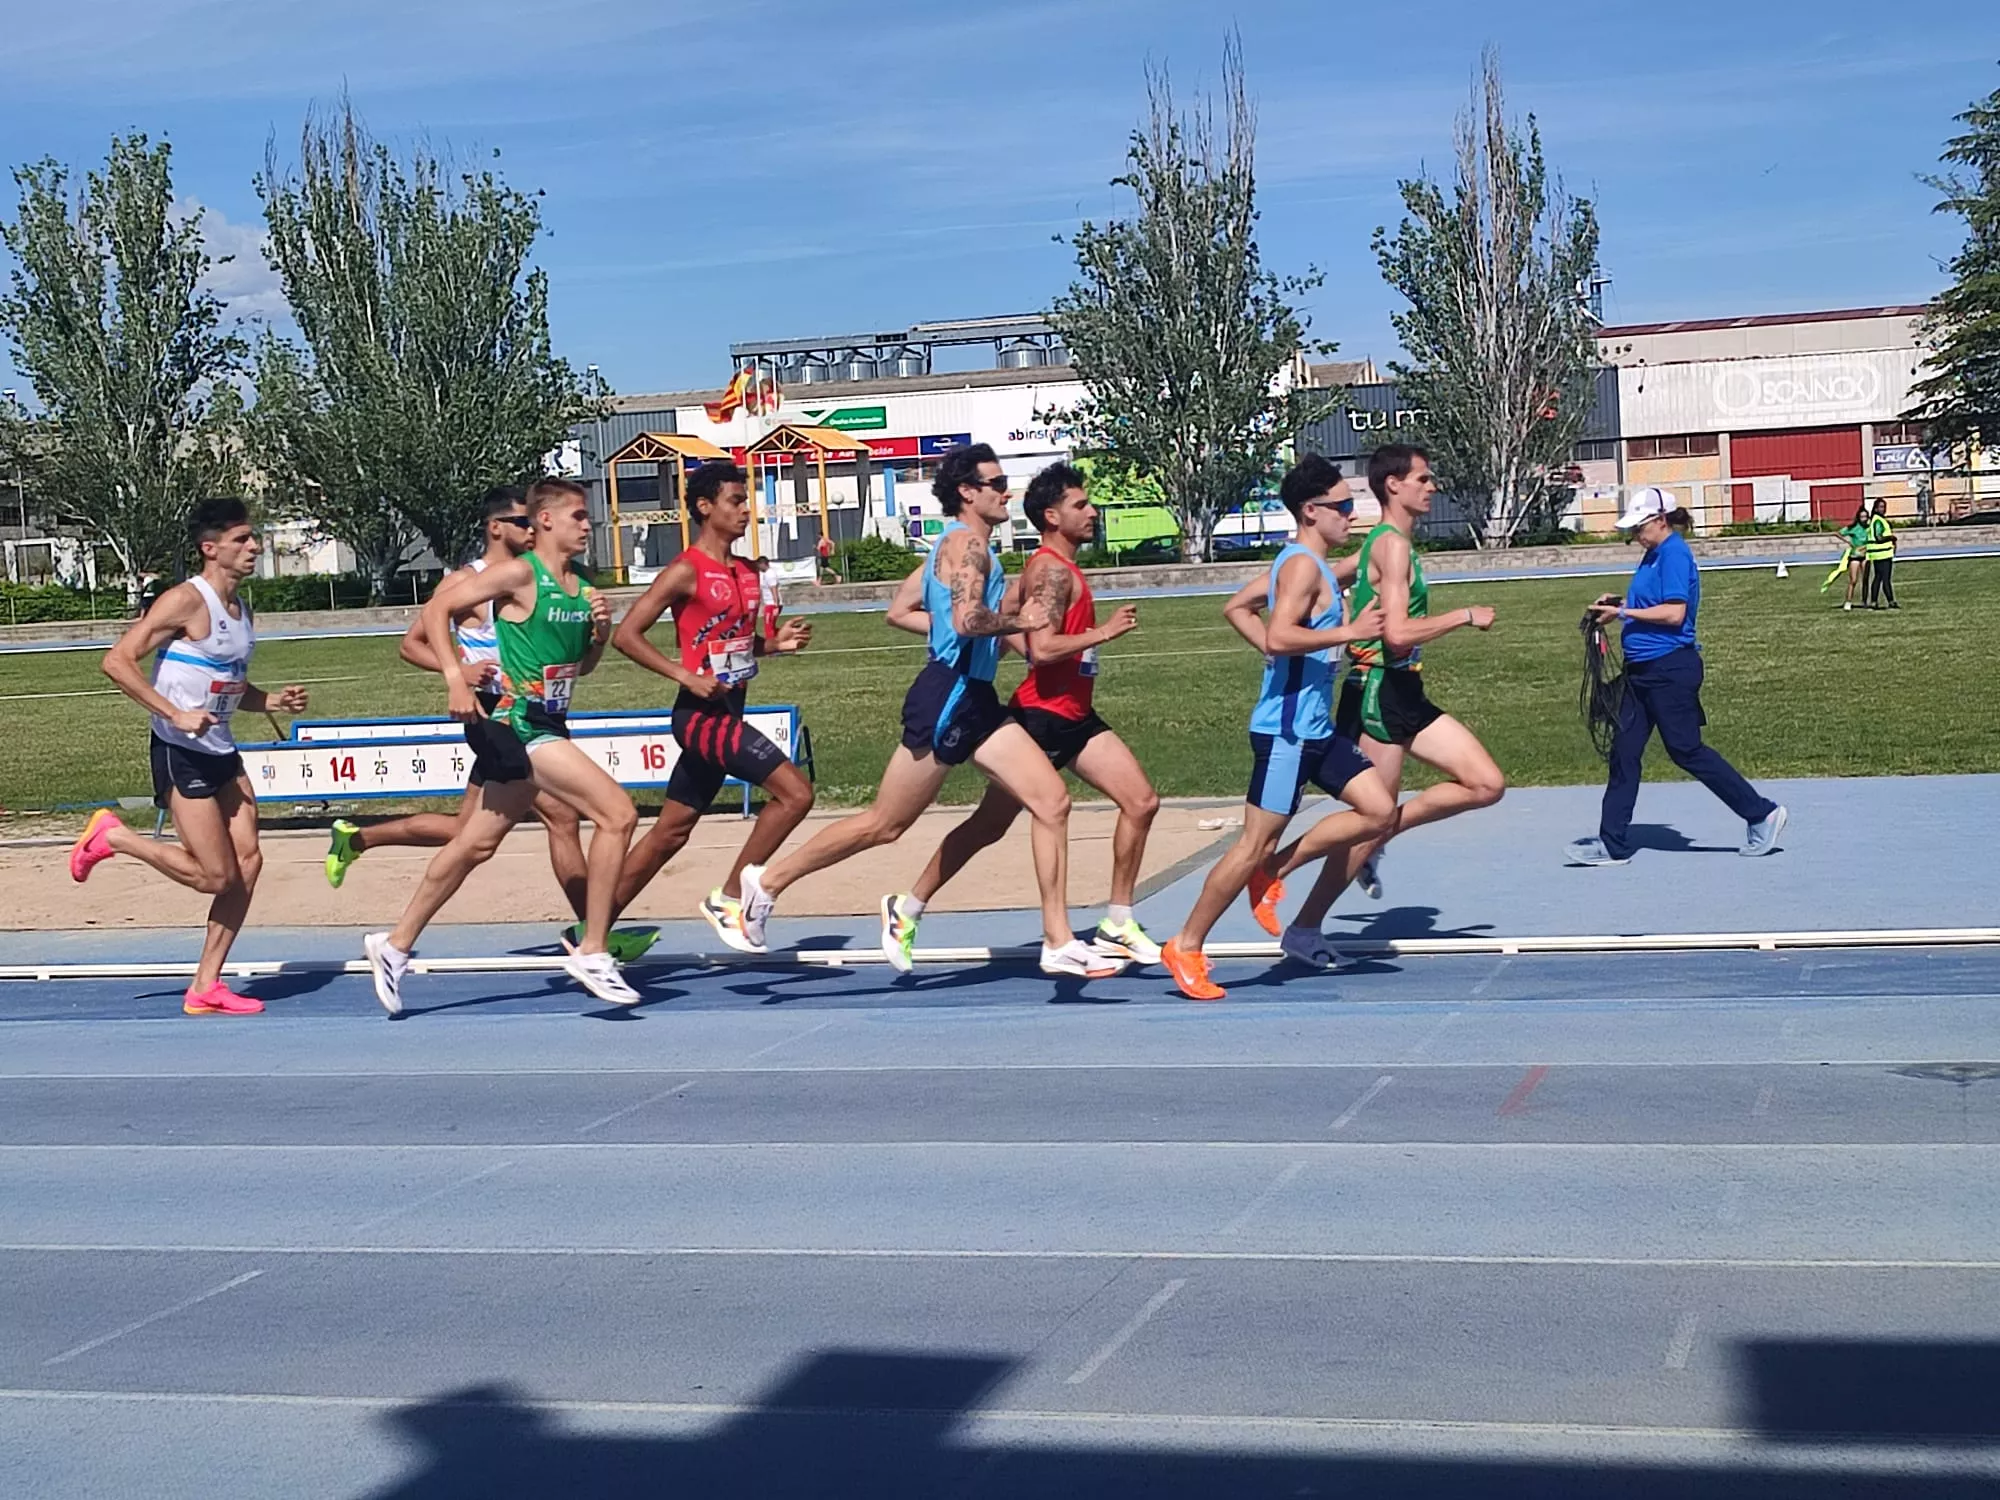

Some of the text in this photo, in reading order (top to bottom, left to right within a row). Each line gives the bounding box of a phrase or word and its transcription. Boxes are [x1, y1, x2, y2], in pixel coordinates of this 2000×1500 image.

[547, 606, 591, 622] Huesc
[552, 680, 566, 697] 22
[775, 727, 788, 741] 50
[262, 744, 666, 782] 50 75 14 25 50 75 75 16
